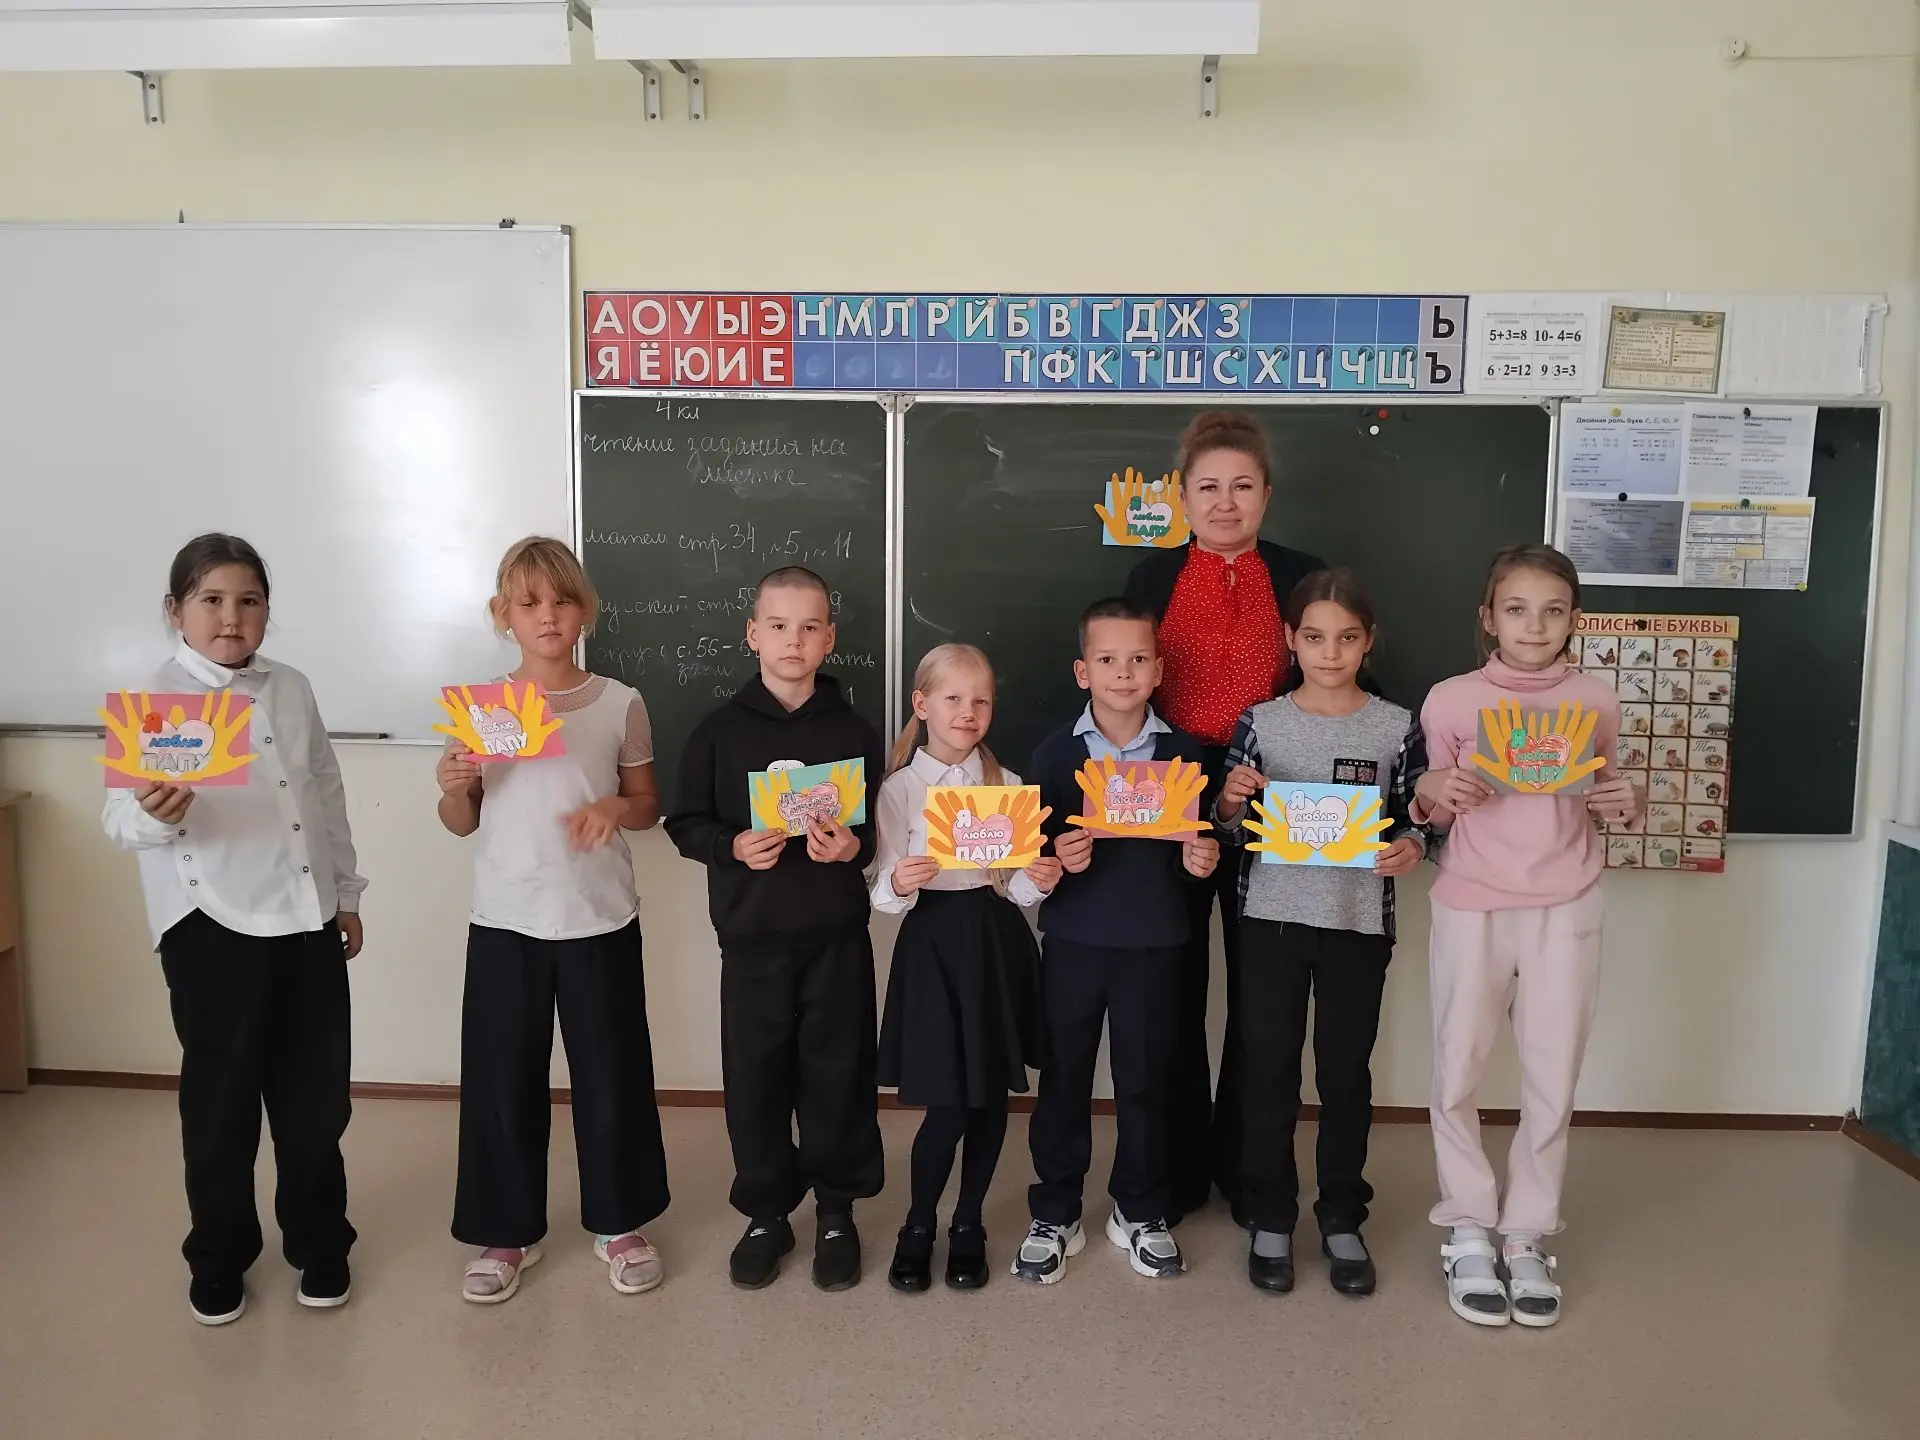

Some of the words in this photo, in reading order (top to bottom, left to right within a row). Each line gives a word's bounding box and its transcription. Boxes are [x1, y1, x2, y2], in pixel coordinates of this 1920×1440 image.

[1489, 329, 1527, 341] 5+3=8
[1667, 619, 1728, 633] БУКВЫ
[482, 732, 528, 755] ПАПУ
[140, 753, 212, 772] ПАПУ
[1289, 790, 1305, 810] Я
[956, 809, 972, 829] Я
[1105, 807, 1164, 824] ПАПУ
[1295, 810, 1338, 822] люблю
[962, 829, 1003, 840] люблю
[1288, 826, 1348, 843] ПАПУ
[955, 843, 1013, 862] ПАПУ
